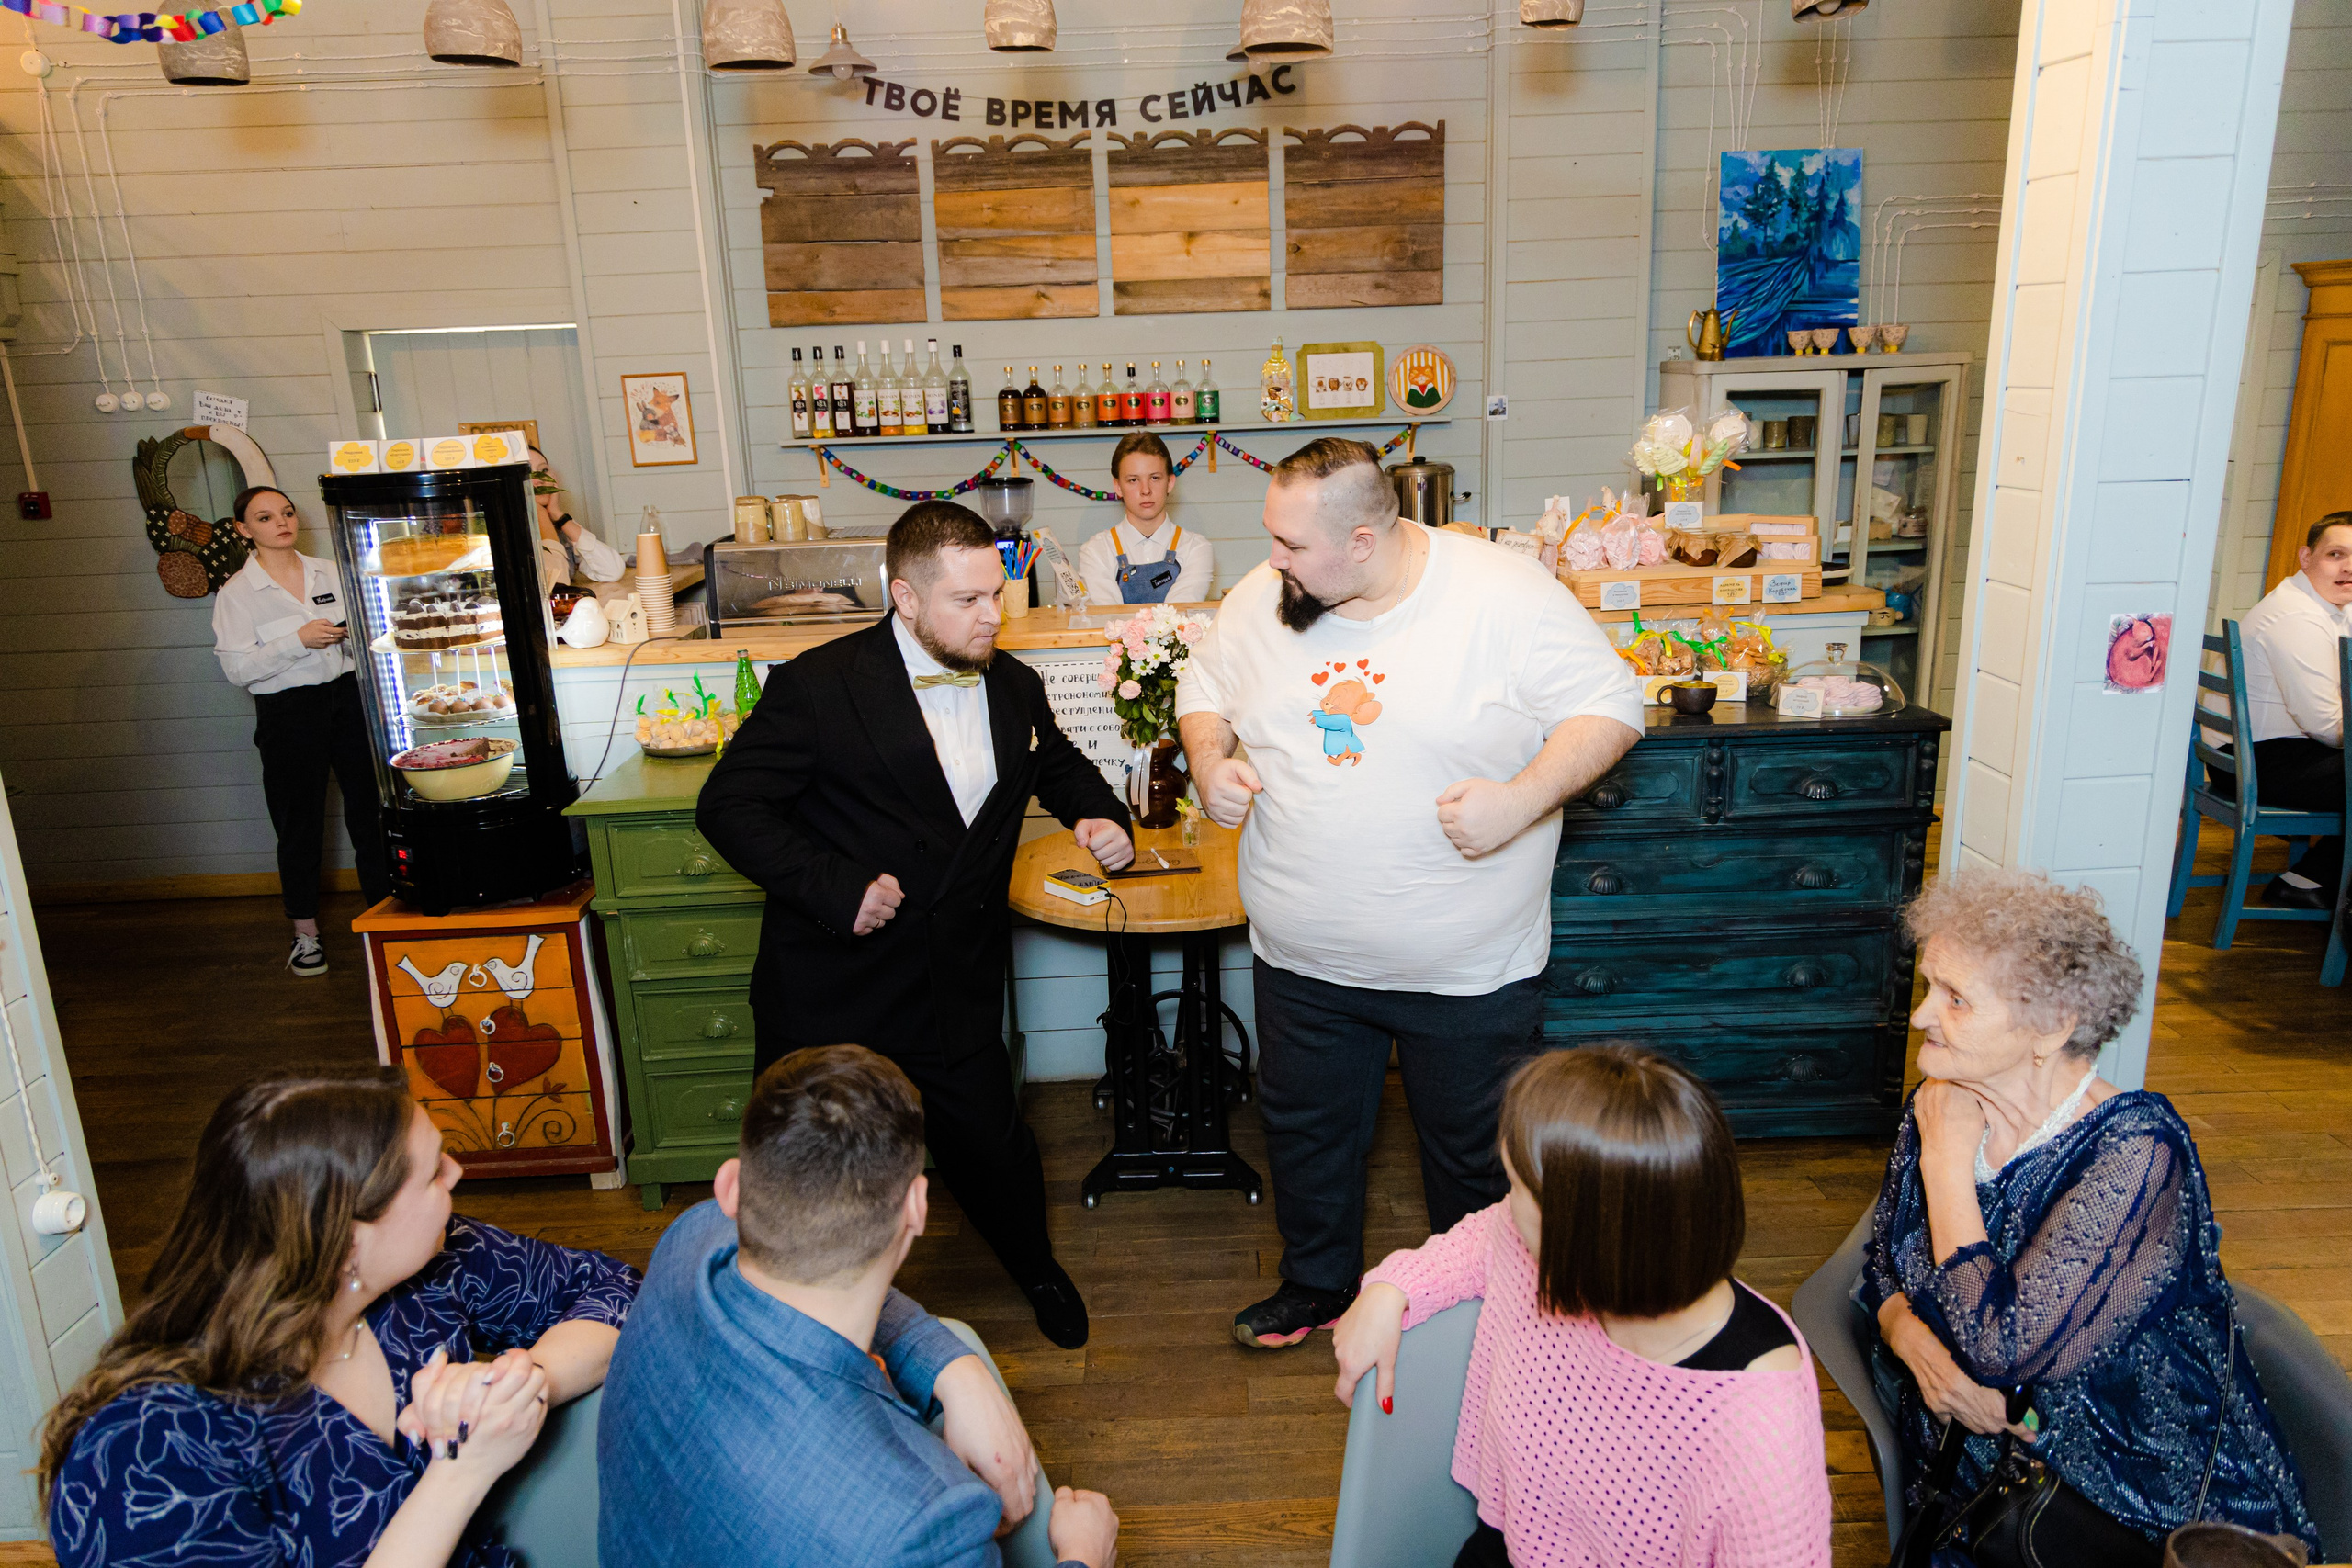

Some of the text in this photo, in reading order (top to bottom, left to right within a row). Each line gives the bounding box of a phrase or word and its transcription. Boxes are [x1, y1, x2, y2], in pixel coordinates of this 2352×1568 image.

[863, 65, 1296, 129] ТВОЁ ВРЕМЯ СЕЙЧАС
[1040, 670, 1100, 686] Не соверш
[1046, 690, 1114, 701] стронономич
[1051, 706, 1115, 716] еступлени
[1097, 724, 1121, 732] собо
[1091, 758, 1126, 768] печку
